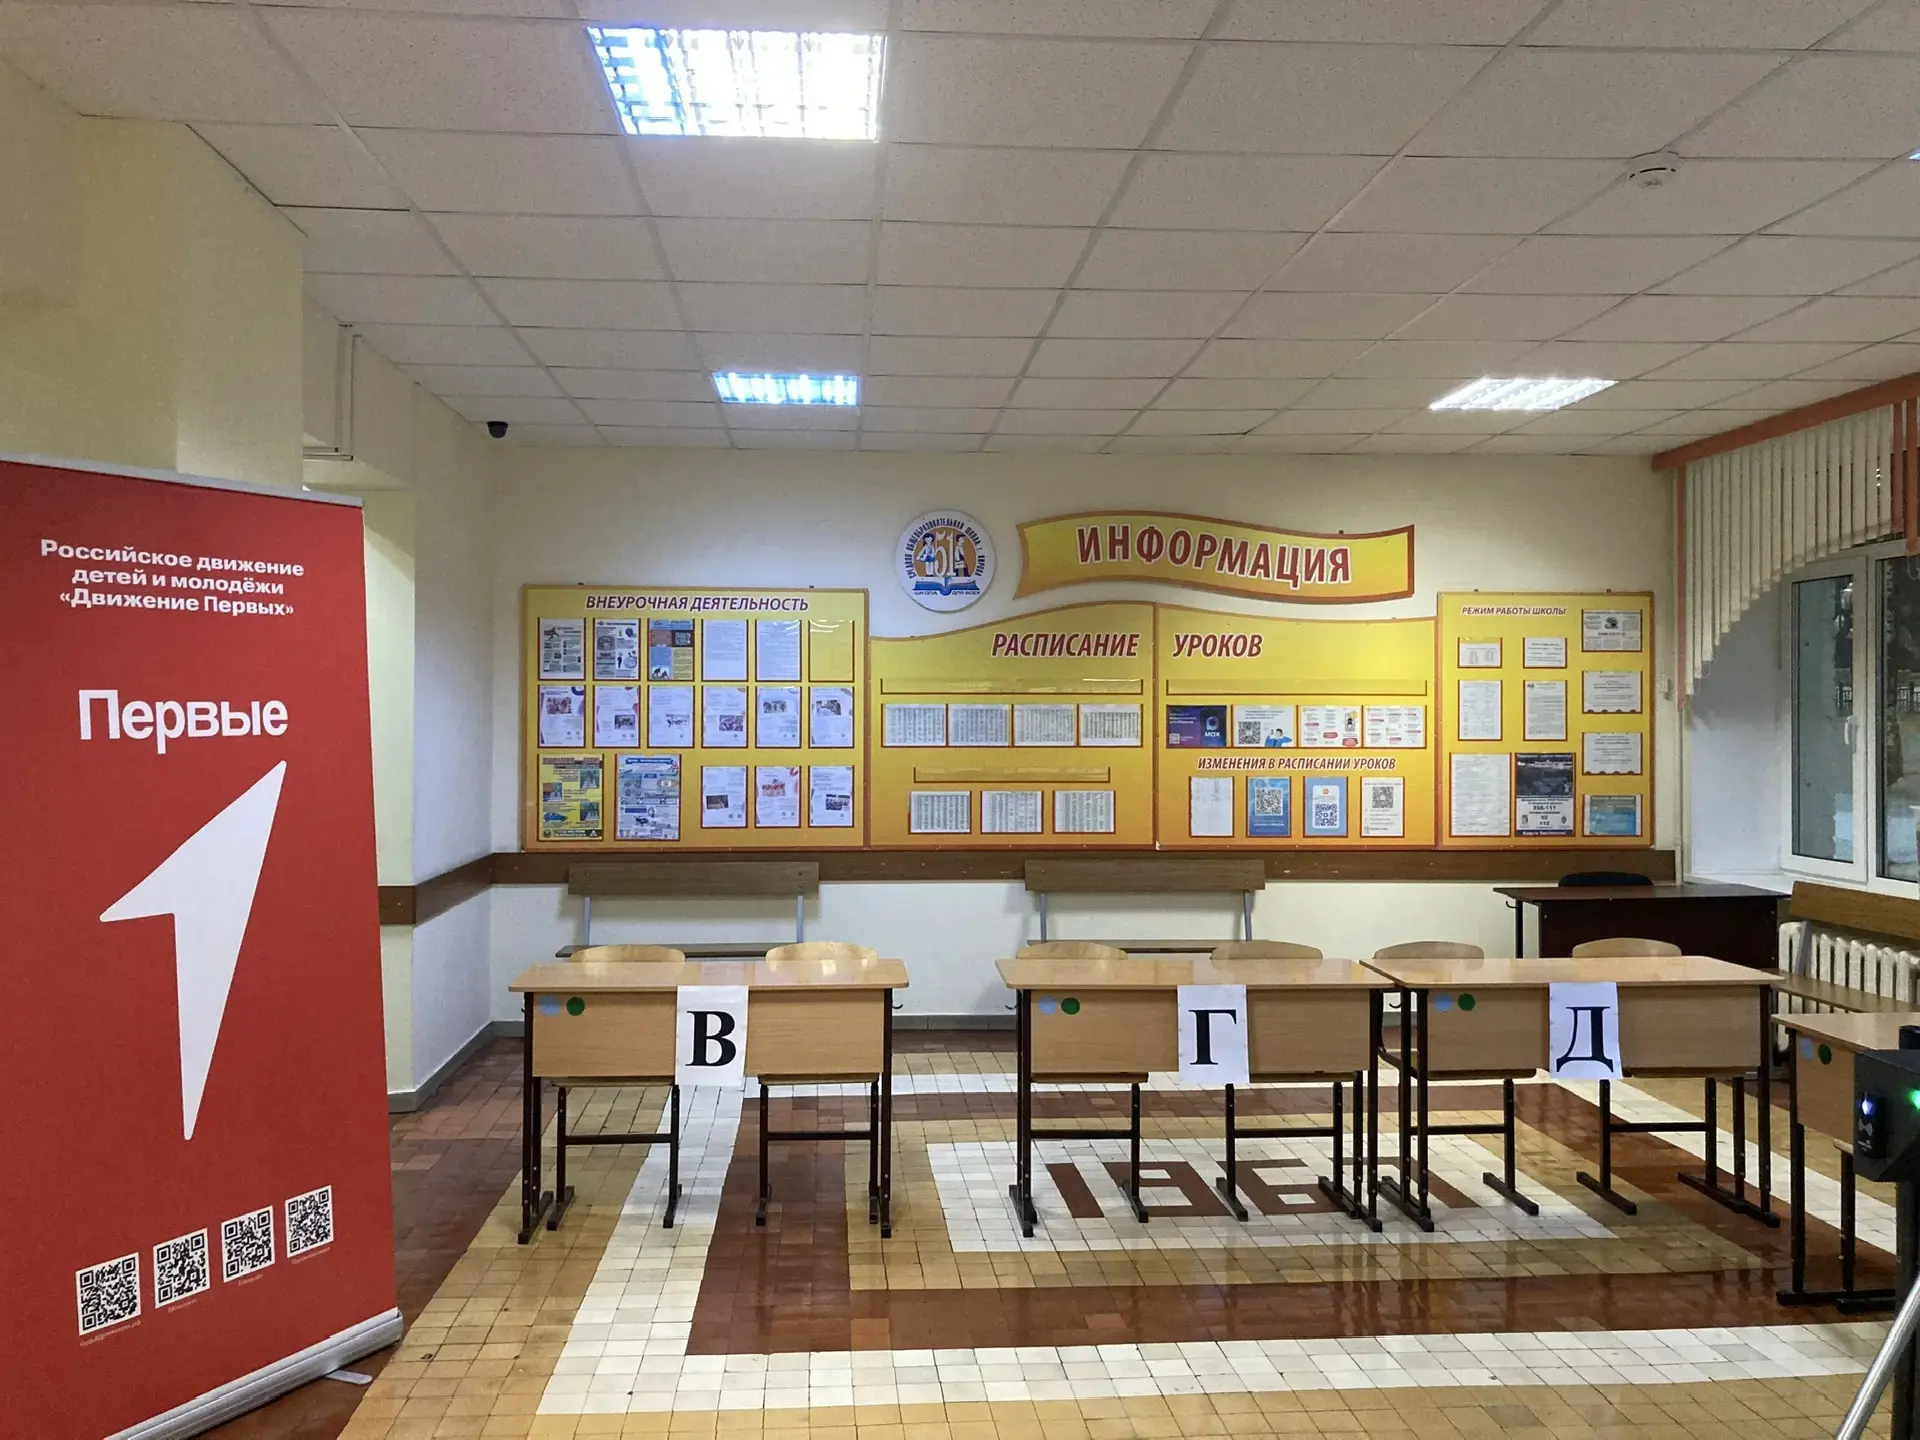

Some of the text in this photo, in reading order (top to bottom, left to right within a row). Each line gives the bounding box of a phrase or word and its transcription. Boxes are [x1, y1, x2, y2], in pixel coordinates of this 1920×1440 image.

[40, 538, 304, 577] Российское движение
[934, 530, 957, 577] 51
[1077, 524, 1352, 590] ИНФОРМАЦИЯ
[72, 566, 284, 596] детей и молодёжи
[59, 587, 294, 617] «Движение Первых»
[586, 595, 809, 612] ВНЕУРОЧНАЯ ДЕЯТЕЛЬНОСТЬ
[1462, 606, 1566, 616] РЕЖИМ РАБОТЫ ШКОЛЫ
[992, 633, 1263, 657] РАСПИСАНИЕ УРОКОВ
[78, 689, 288, 754] Первые
[1198, 757, 1396, 770] ИЗМЕНЕНИЯ В РАСПИСАНИИ УРОКОВ
[690, 1011, 738, 1068] В
[1189, 1009, 1239, 1065] Г
[1555, 1005, 1614, 1073] Д
